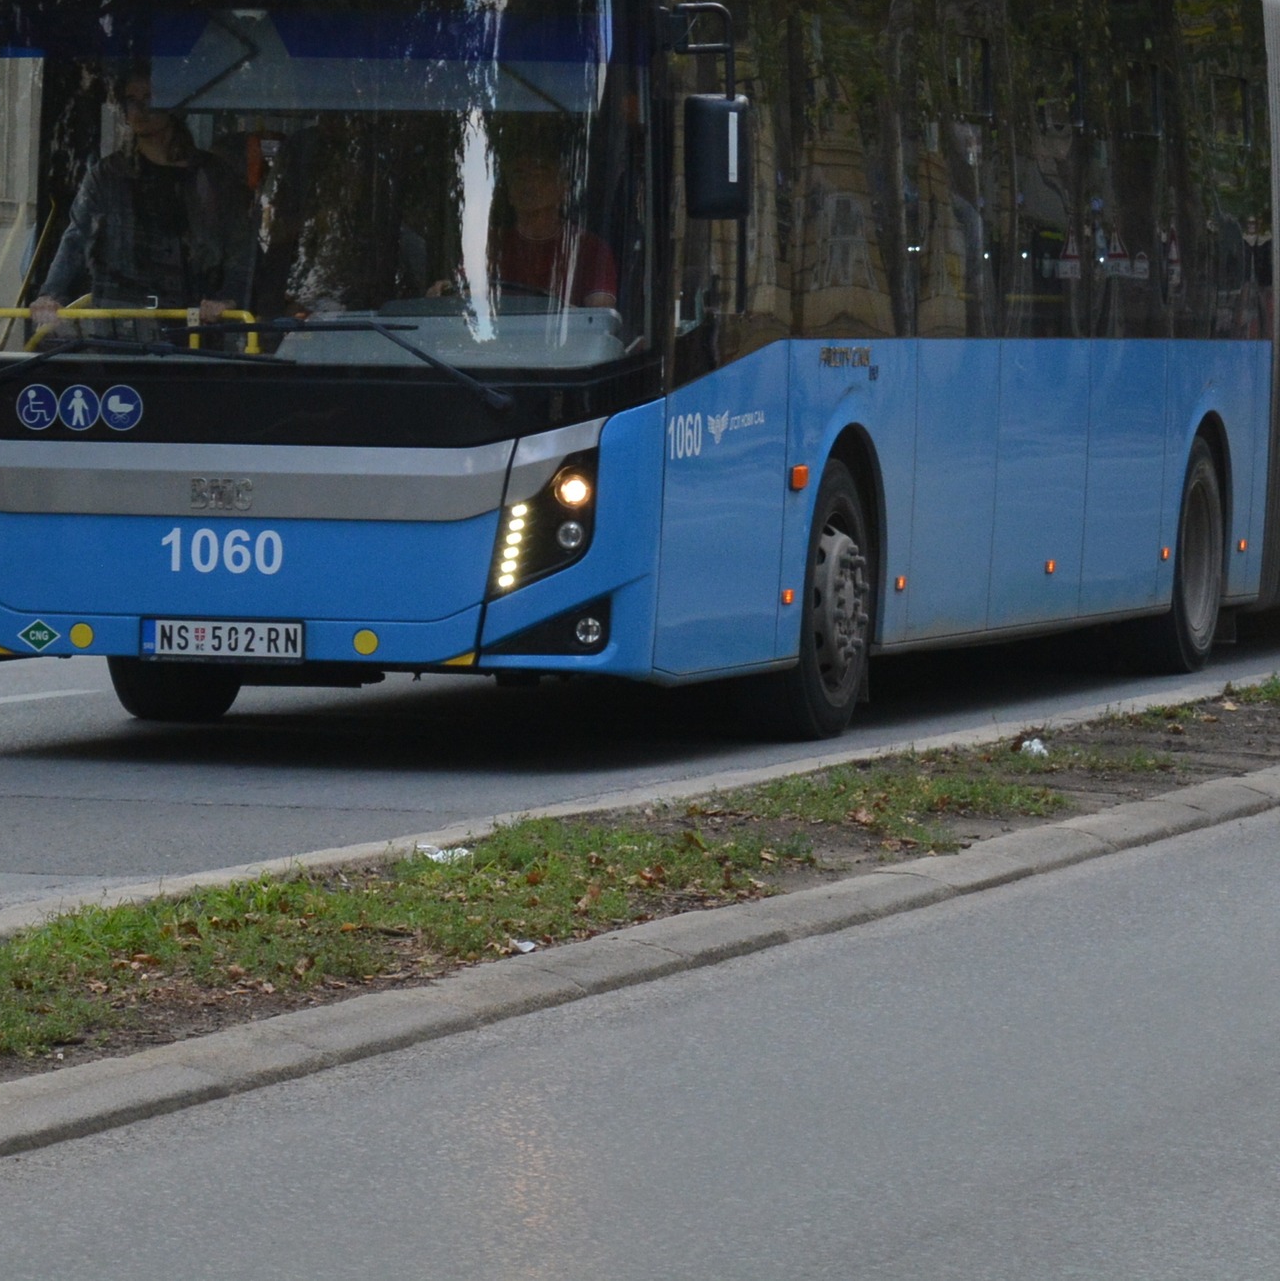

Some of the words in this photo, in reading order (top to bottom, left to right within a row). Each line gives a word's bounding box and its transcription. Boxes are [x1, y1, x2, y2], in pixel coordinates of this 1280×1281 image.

[668, 412, 702, 460] 1060
[190, 476, 254, 512] BMC
[160, 526, 284, 576] 1060
[28, 630, 50, 642] CNG
[160, 625, 190, 651] NS
